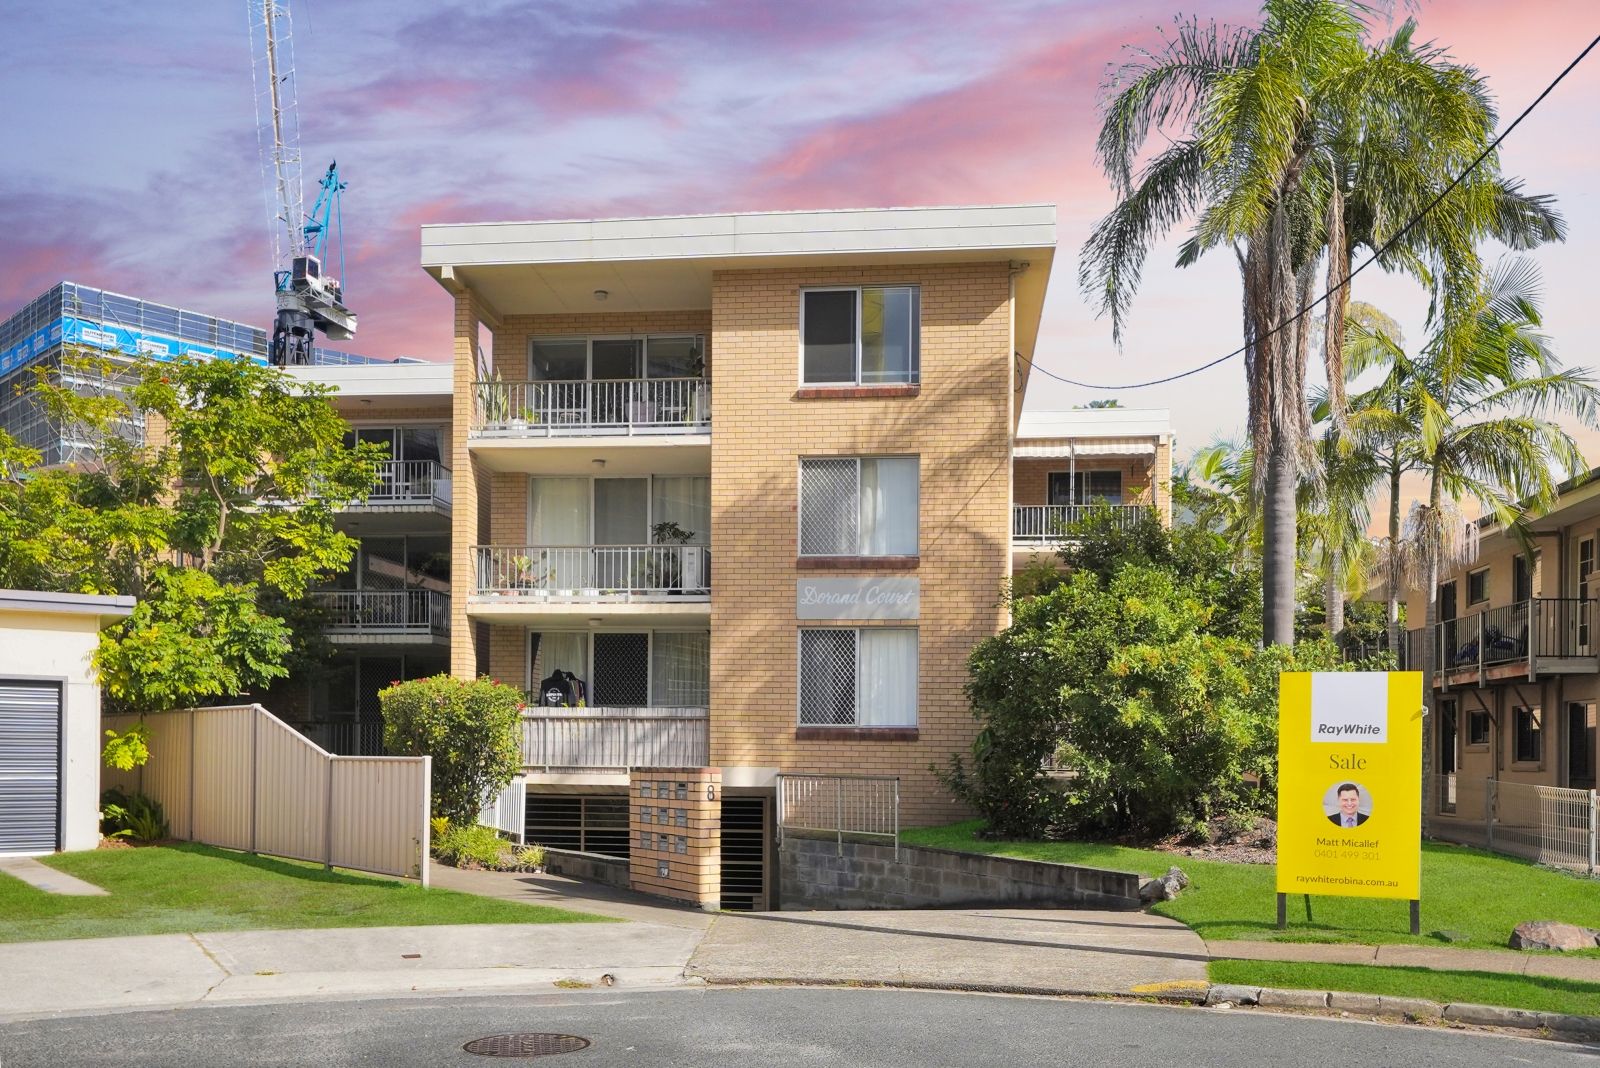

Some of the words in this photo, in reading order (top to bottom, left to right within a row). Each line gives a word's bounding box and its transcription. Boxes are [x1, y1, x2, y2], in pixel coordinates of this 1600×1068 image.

[800, 586, 862, 605] Dorand
[865, 586, 915, 605] Court
[1329, 753, 1367, 770] Sale
[707, 784, 715, 801] 8
[1316, 838, 1339, 847] Matt
[1341, 839, 1380, 848] Micallef
[1314, 849, 1338, 859] 0401
[1341, 850, 1360, 860] 499
[1362, 851, 1380, 861] 301
[1296, 875, 1398, 887] raywhiterobina.com.au
